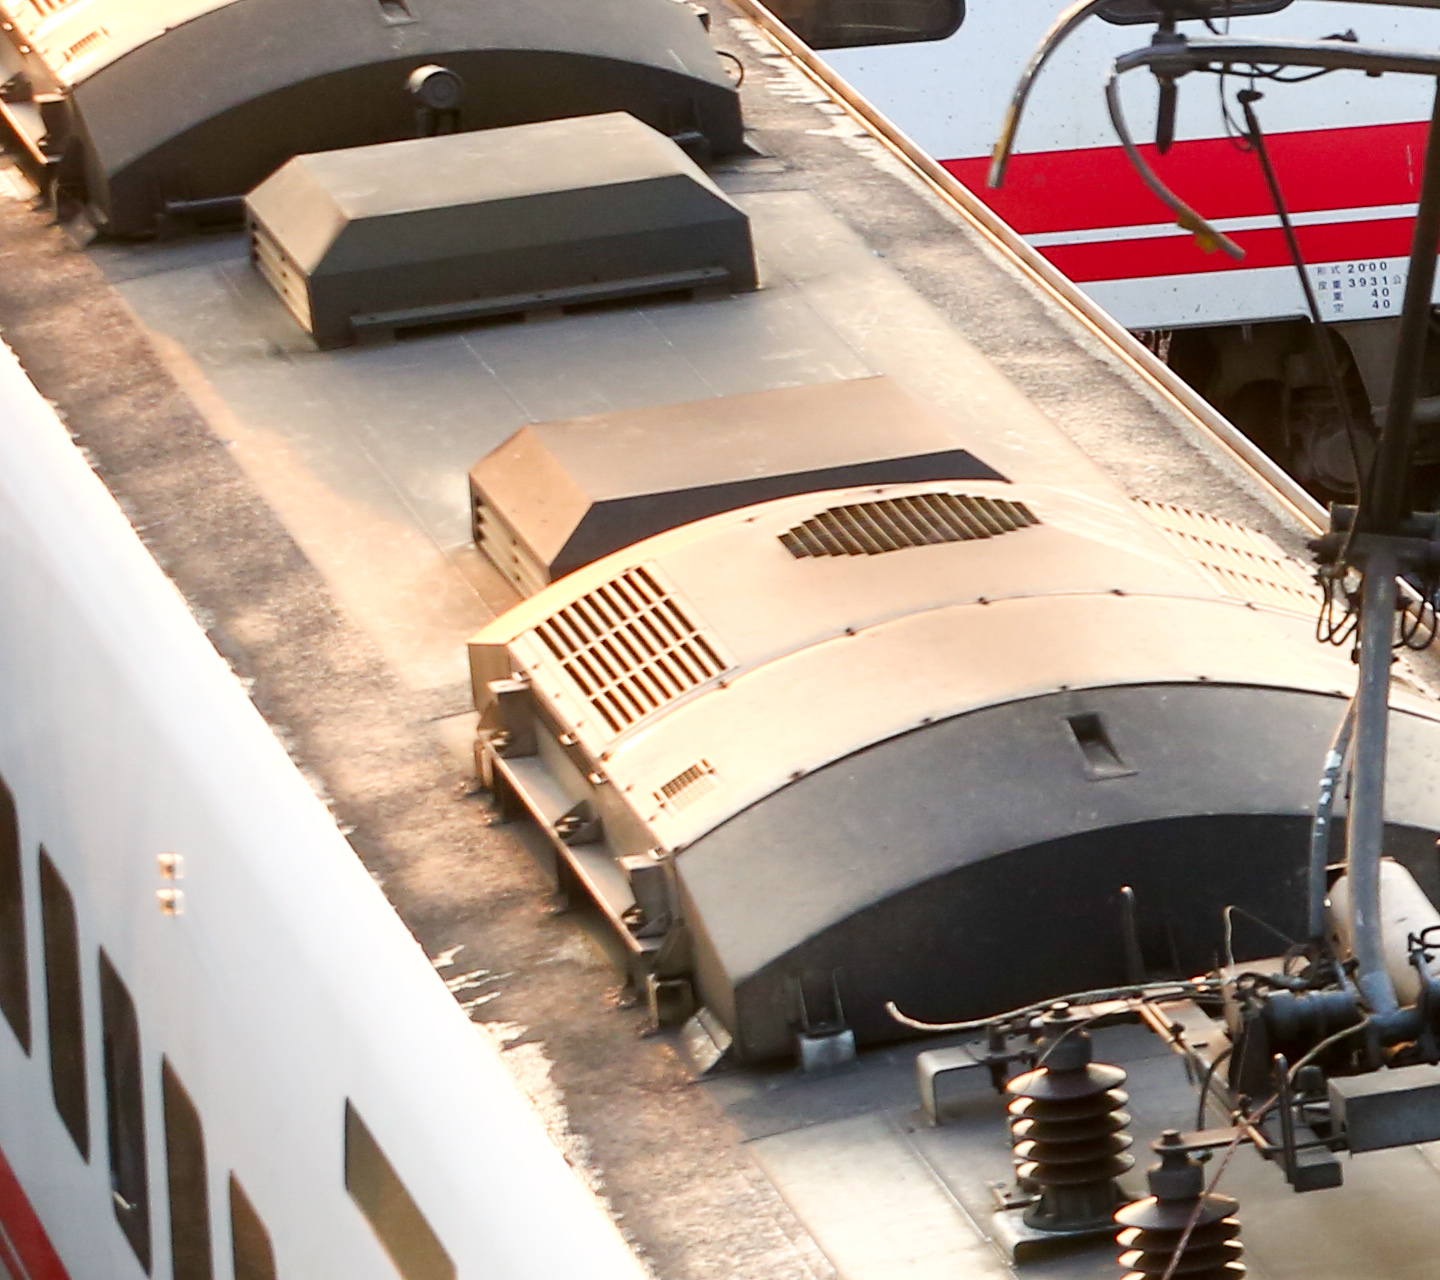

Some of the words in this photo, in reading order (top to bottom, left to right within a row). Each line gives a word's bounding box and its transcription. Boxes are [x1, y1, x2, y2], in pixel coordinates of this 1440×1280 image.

[1347, 261, 1387, 274] 2000
[1348, 275, 1388, 288] 3931
[1371, 287, 1390, 298] 40
[1372, 299, 1391, 310] 40
